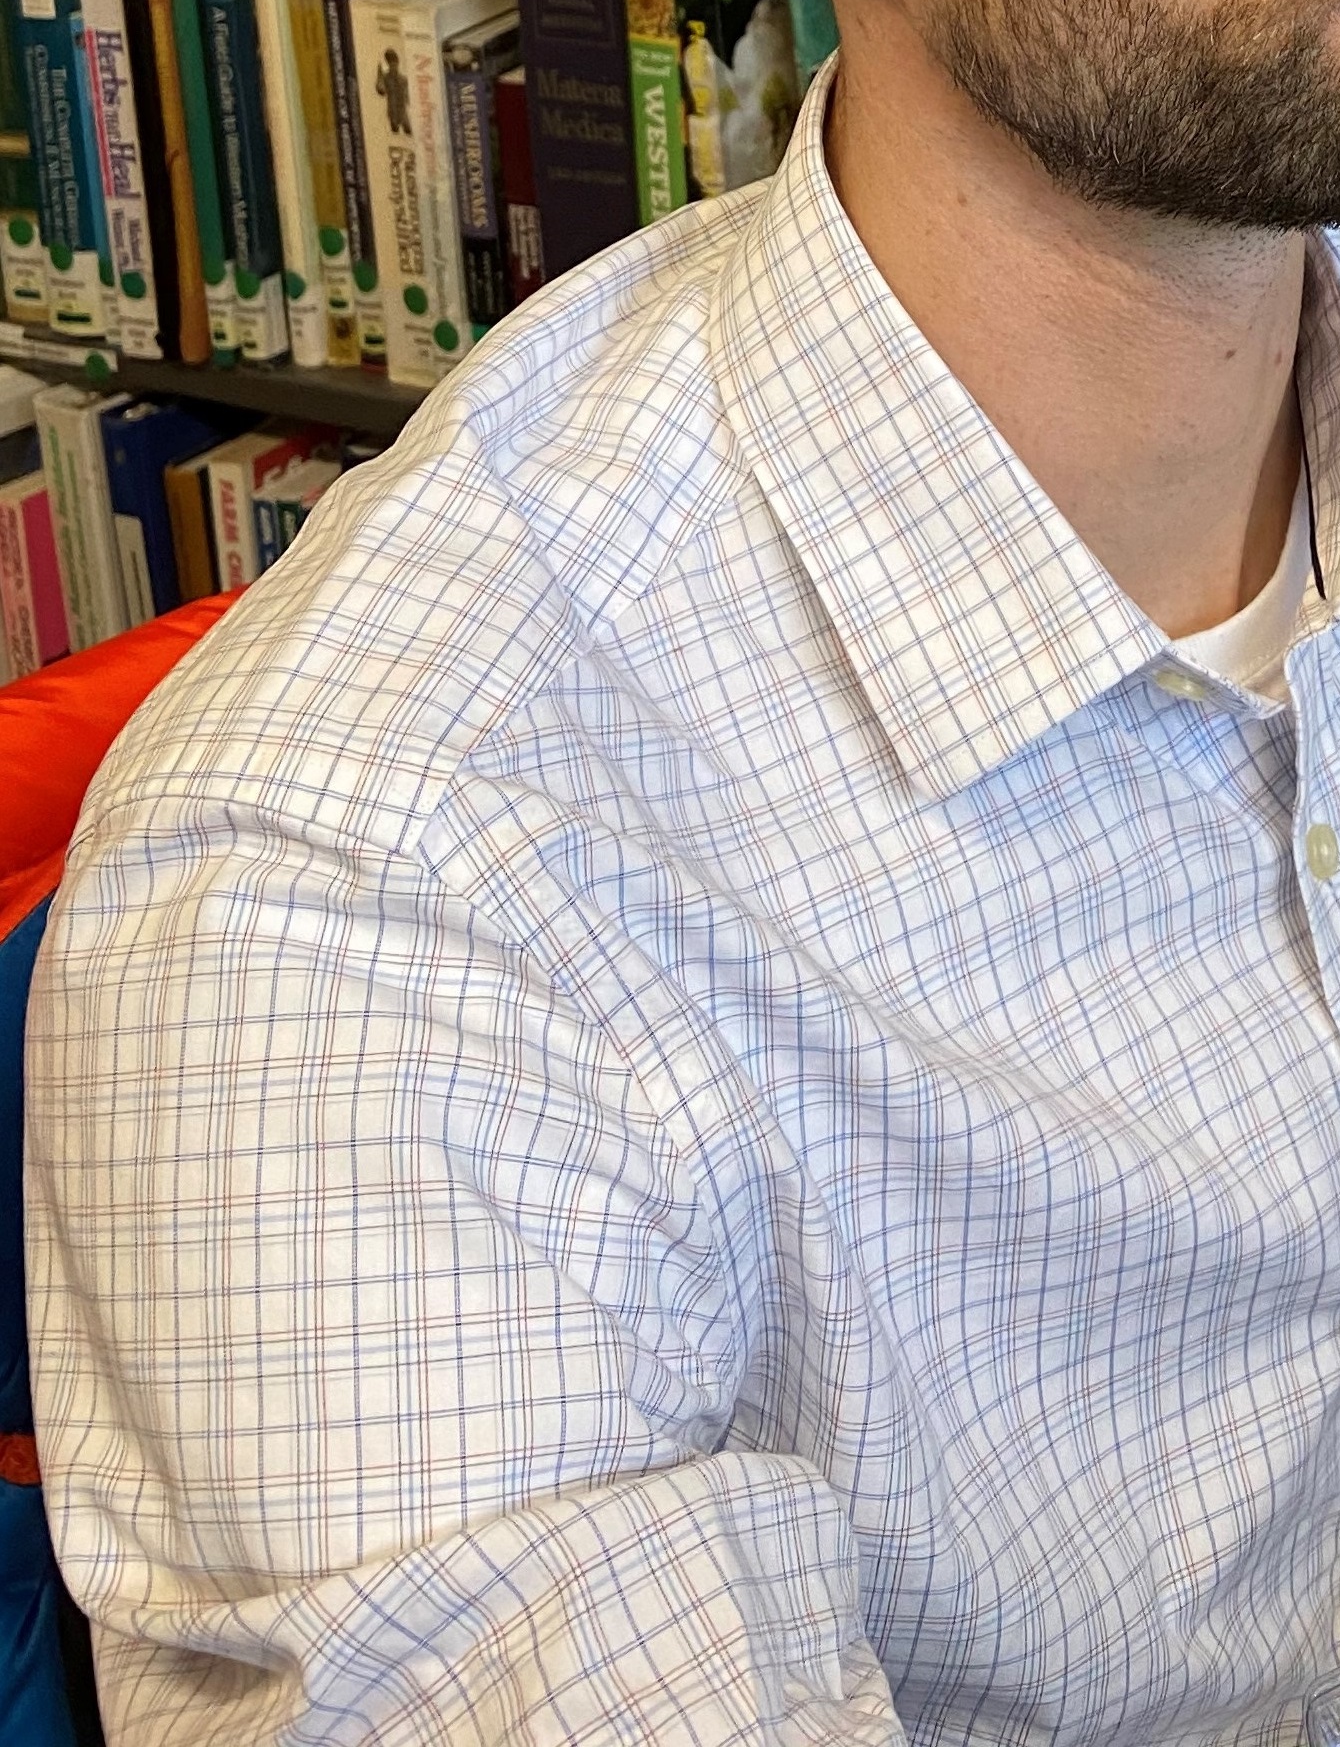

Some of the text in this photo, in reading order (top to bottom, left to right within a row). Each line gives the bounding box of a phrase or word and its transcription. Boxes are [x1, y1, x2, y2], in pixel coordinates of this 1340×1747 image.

[96, 30, 128, 105] Herbs
[108, 142, 141, 199] Heal
[459, 81, 489, 229] MUSHROOMS
[219, 479, 243, 544] FARM
